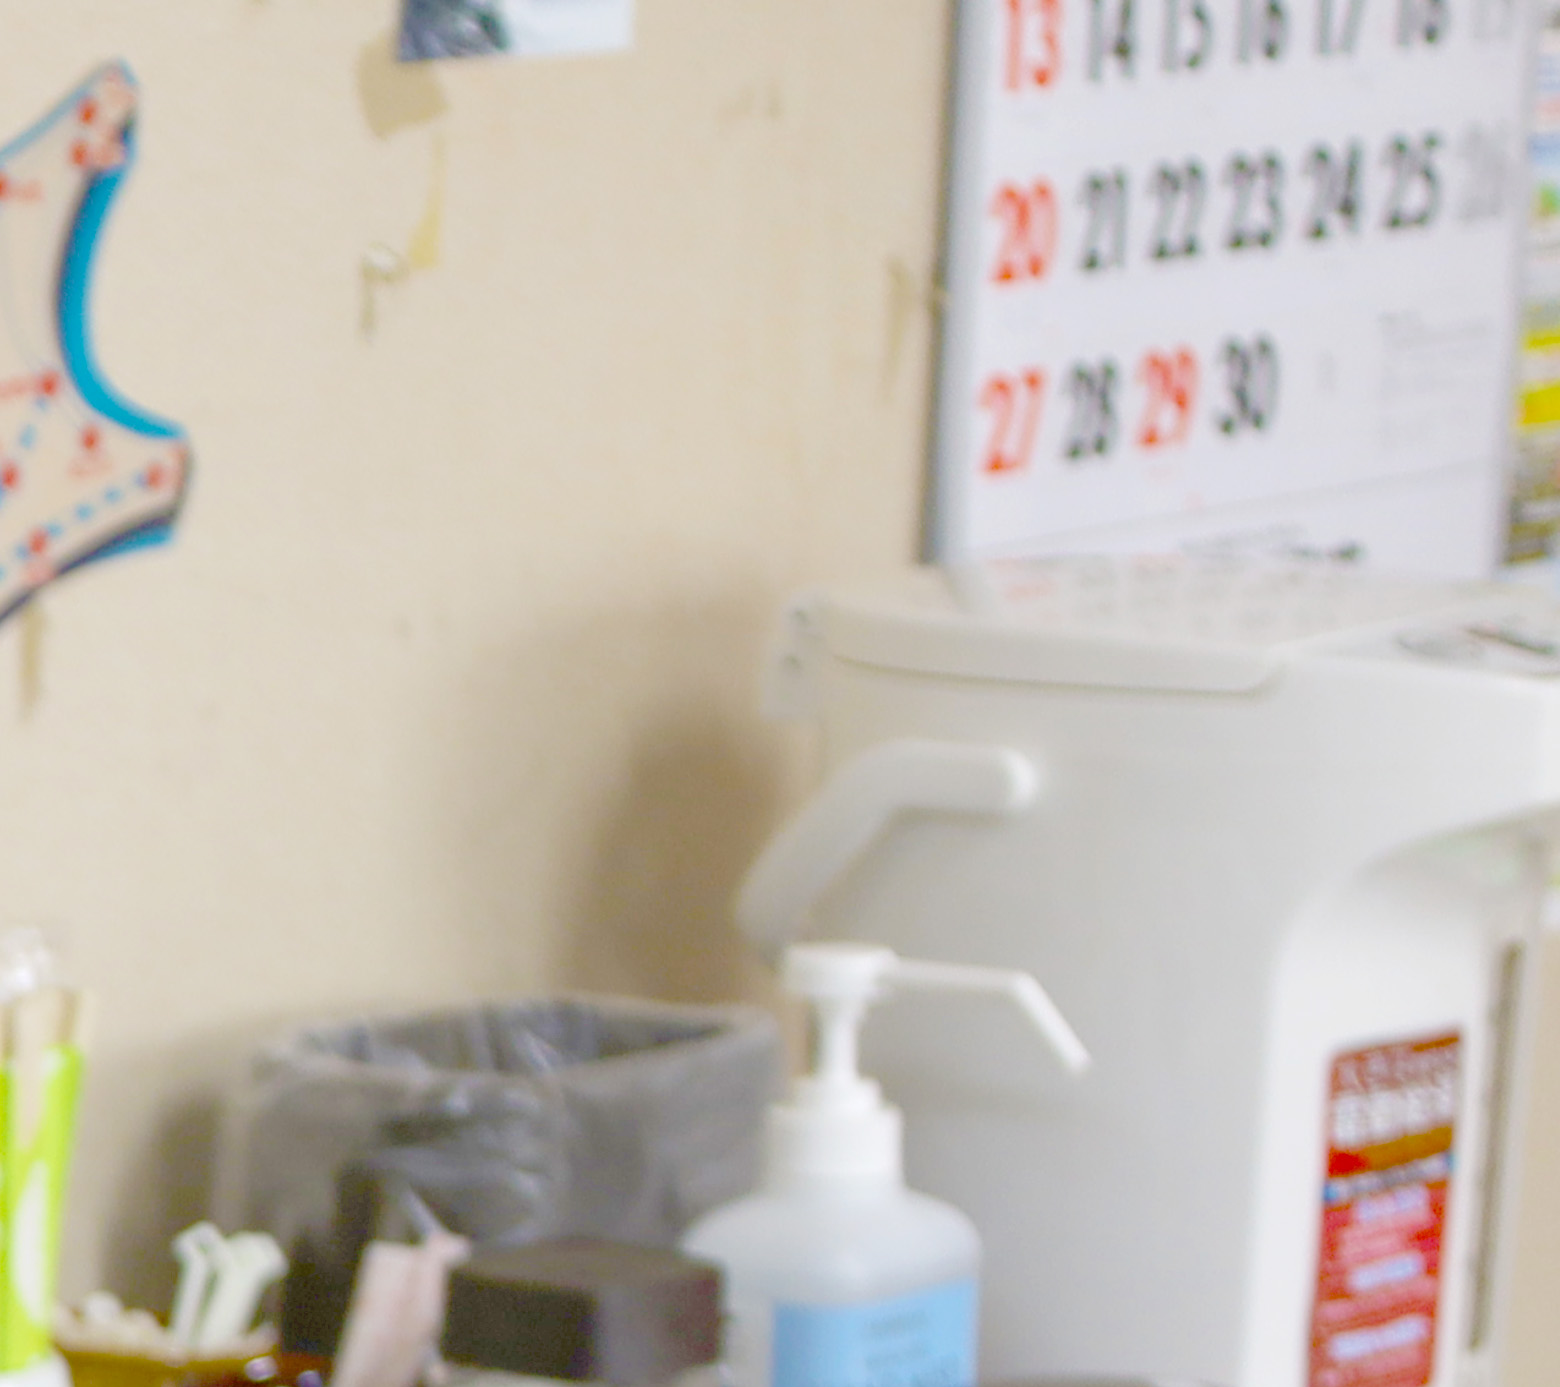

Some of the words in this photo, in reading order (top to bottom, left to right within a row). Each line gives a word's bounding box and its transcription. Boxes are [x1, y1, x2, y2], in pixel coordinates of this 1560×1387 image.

[990, 178, 1058, 286] 20
[1079, 166, 1127, 271] 21
[1150, 154, 1205, 260] 22
[1225, 147, 1285, 250] 23
[1303, 136, 1363, 241] 24
[1383, 128, 1442, 230] 25
[979, 365, 1046, 477] 27
[1063, 354, 1118, 463] 28
[1135, 344, 1200, 449] 29
[1216, 331, 1280, 436] 30
